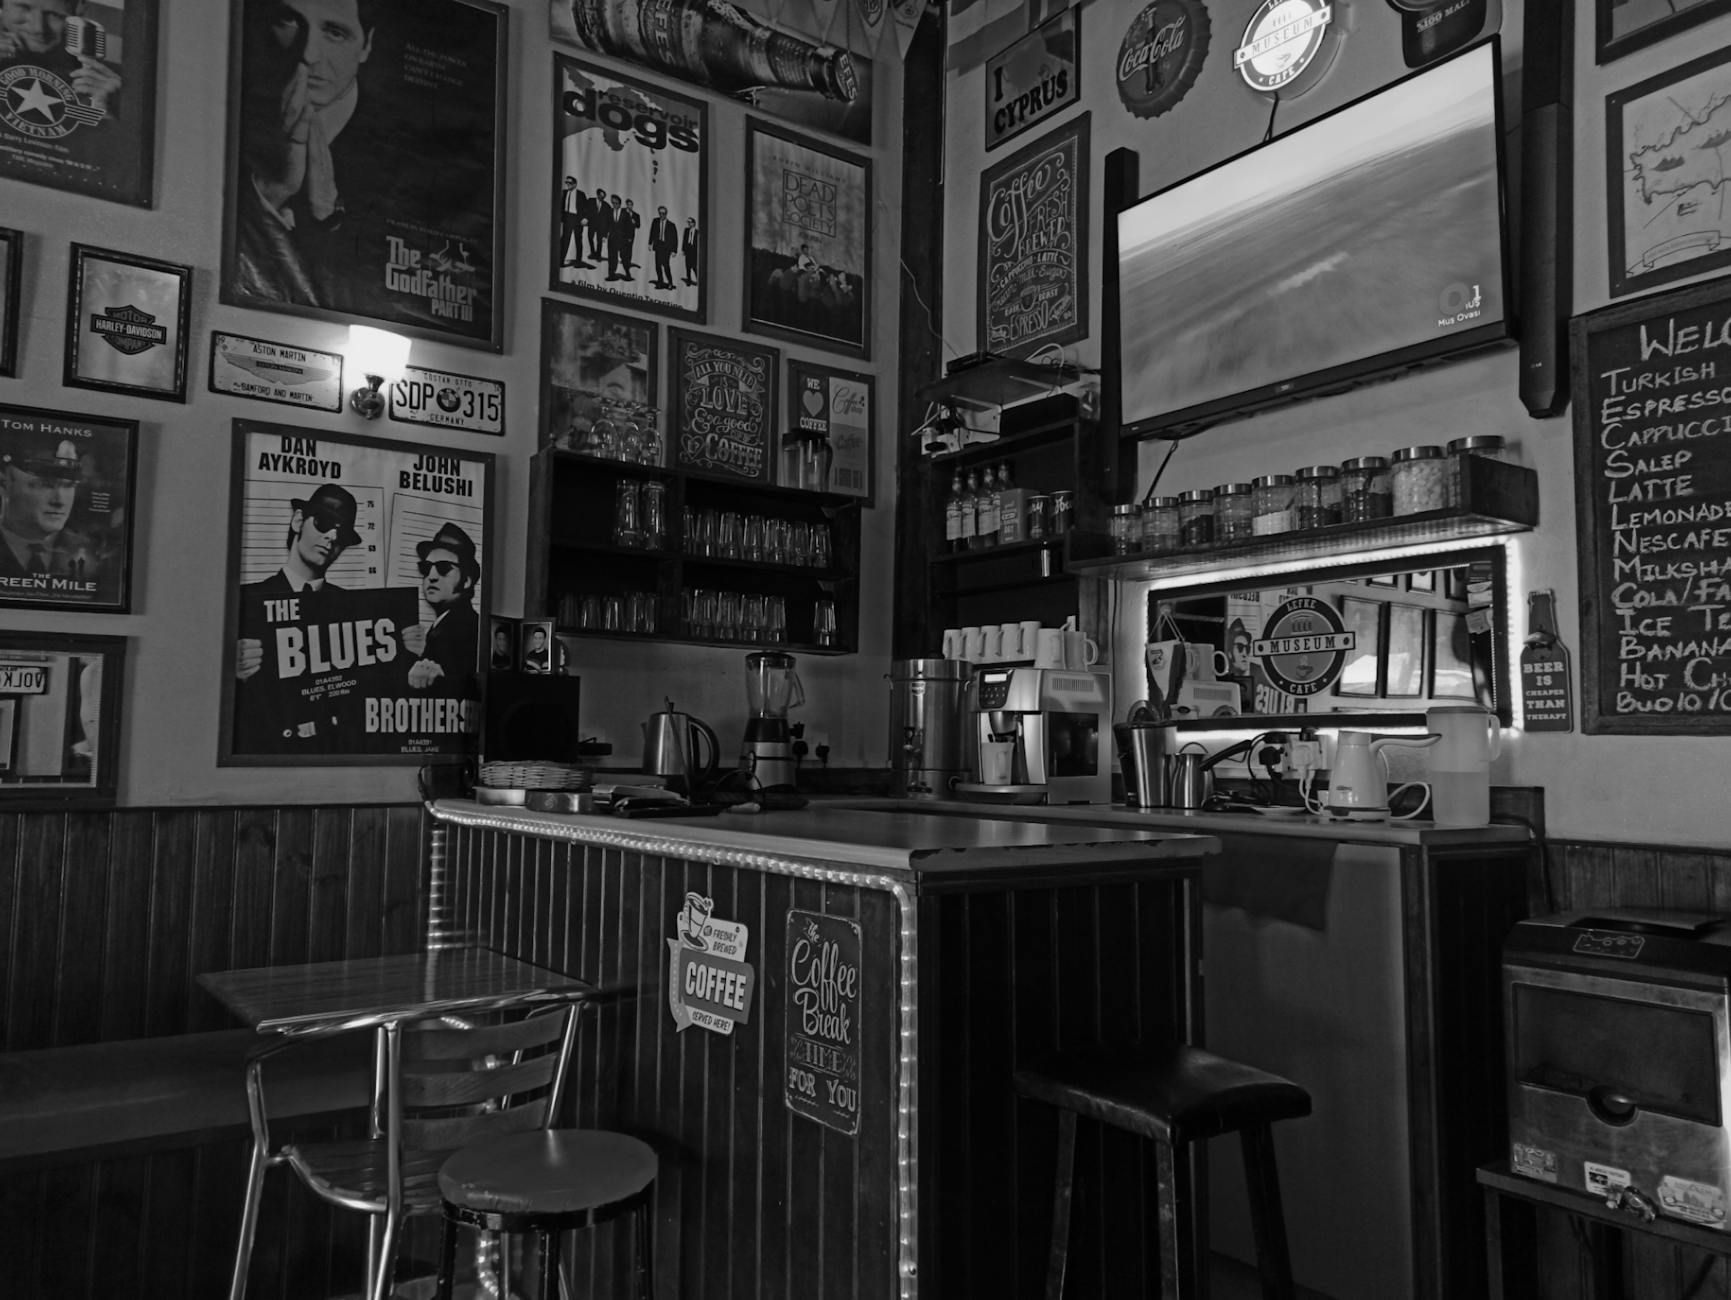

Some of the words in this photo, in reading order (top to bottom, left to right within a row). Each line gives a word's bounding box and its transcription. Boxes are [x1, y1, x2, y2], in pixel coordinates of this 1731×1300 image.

[1252, 16, 1314, 56] MUSEUM
[994, 66, 1004, 102] I
[598, 90, 698, 128] reservoir
[994, 69, 1068, 135] CYPRUS
[5, 113, 68, 137] VIETNAM
[564, 88, 699, 152] dogs
[785, 172, 834, 203] DEAD
[785, 192, 835, 222] POETS
[784, 209, 835, 234] SOCIETY
[386, 235, 421, 268] The
[386, 262, 478, 305] Godfather
[431, 298, 459, 319] PART
[96, 319, 162, 339] HARLEY-DAVIDSON
[253, 344, 277, 356] ASTON
[280, 350, 306, 362] MARTIN
[696, 362, 711, 377] ALL
[713, 361, 731, 374] YOU
[1600, 361, 1716, 396] TURKISH
[273, 388, 286, 397] AND
[290, 391, 313, 402] MARTIN
[807, 377, 821, 389] WE
[396, 379, 434, 411] SDP
[463, 390, 499, 421] 315
[700, 386, 748, 415] LOVE
[800, 417, 828, 431] COFFEE
[281, 436, 316, 457] DAN
[705, 433, 763, 469] COFFEE
[259, 453, 341, 479] AYKROYD
[413, 454, 460, 476] JOHN
[1604, 449, 1693, 478] SALEP
[399, 471, 473, 497] BELUSHI
[1608, 474, 1694, 505] LATTE
[52, 578, 97, 592] MILE
[263, 598, 301, 623] THE
[1615, 609, 1673, 637] ICE
[275, 617, 398, 680] BLUES
[1270, 636, 1336, 653] MUSEUM
[1523, 662, 1564, 674] BEER
[1536, 675, 1552, 686] IS
[1620, 661, 1670, 690] HOT
[1289, 683, 1318, 694] CAFE
[1526, 699, 1565, 709] THAN
[713, 929, 737, 942] FRESHLY
[713, 942, 737, 955] BREWED
[685, 961, 747, 1011] COFFEE
[791, 938, 857, 1014] Coffee
[794, 987, 852, 1045] Break
[789, 1066, 816, 1098] FOR
[826, 1079, 857, 1112] YOU
